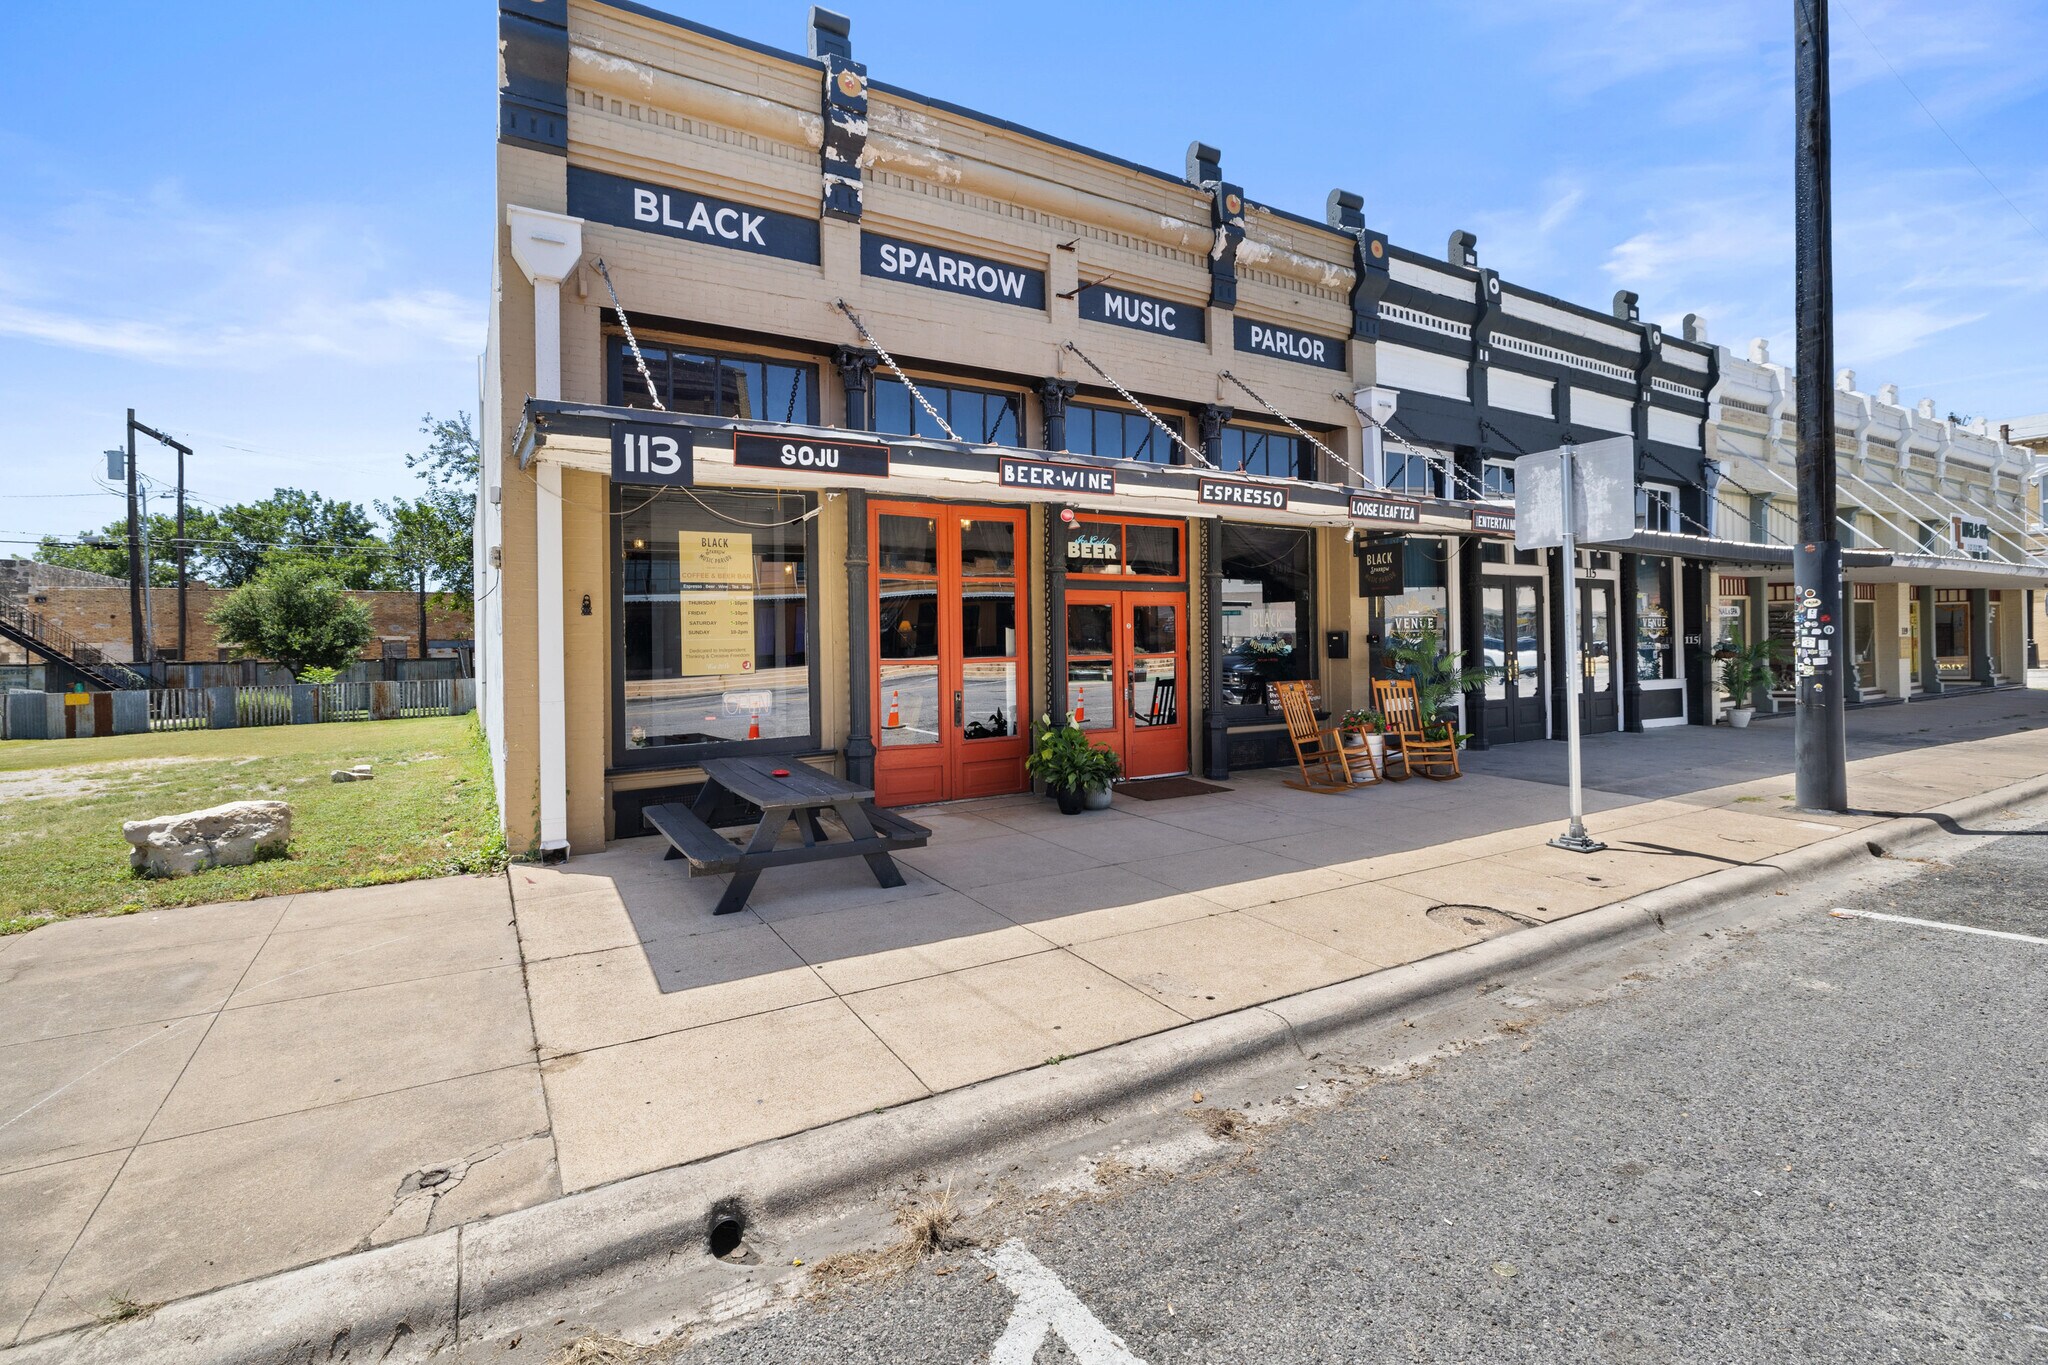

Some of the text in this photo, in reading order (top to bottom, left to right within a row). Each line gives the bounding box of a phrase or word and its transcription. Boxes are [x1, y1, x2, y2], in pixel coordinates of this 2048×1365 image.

[633, 187, 1325, 363] BLACK SPARROW MUSIC PARLOR
[624, 433, 682, 475] 113
[780, 444, 839, 468] SOJU
[1203, 485, 1283, 507] ESPRESSO
[1352, 501, 1415, 520] LOOSE LEAF TEA
[701, 537, 729, 548] BLACK
[1067, 541, 1117, 560] BEER
[1366, 551, 1393, 566] BLACK
[1585, 568, 1597, 578] 115
[1252, 612, 1282, 628] BLACK
[1395, 617, 1434, 629] VENUE
[1642, 617, 1667, 627] VENUE
[1684, 636, 1699, 645] 115
